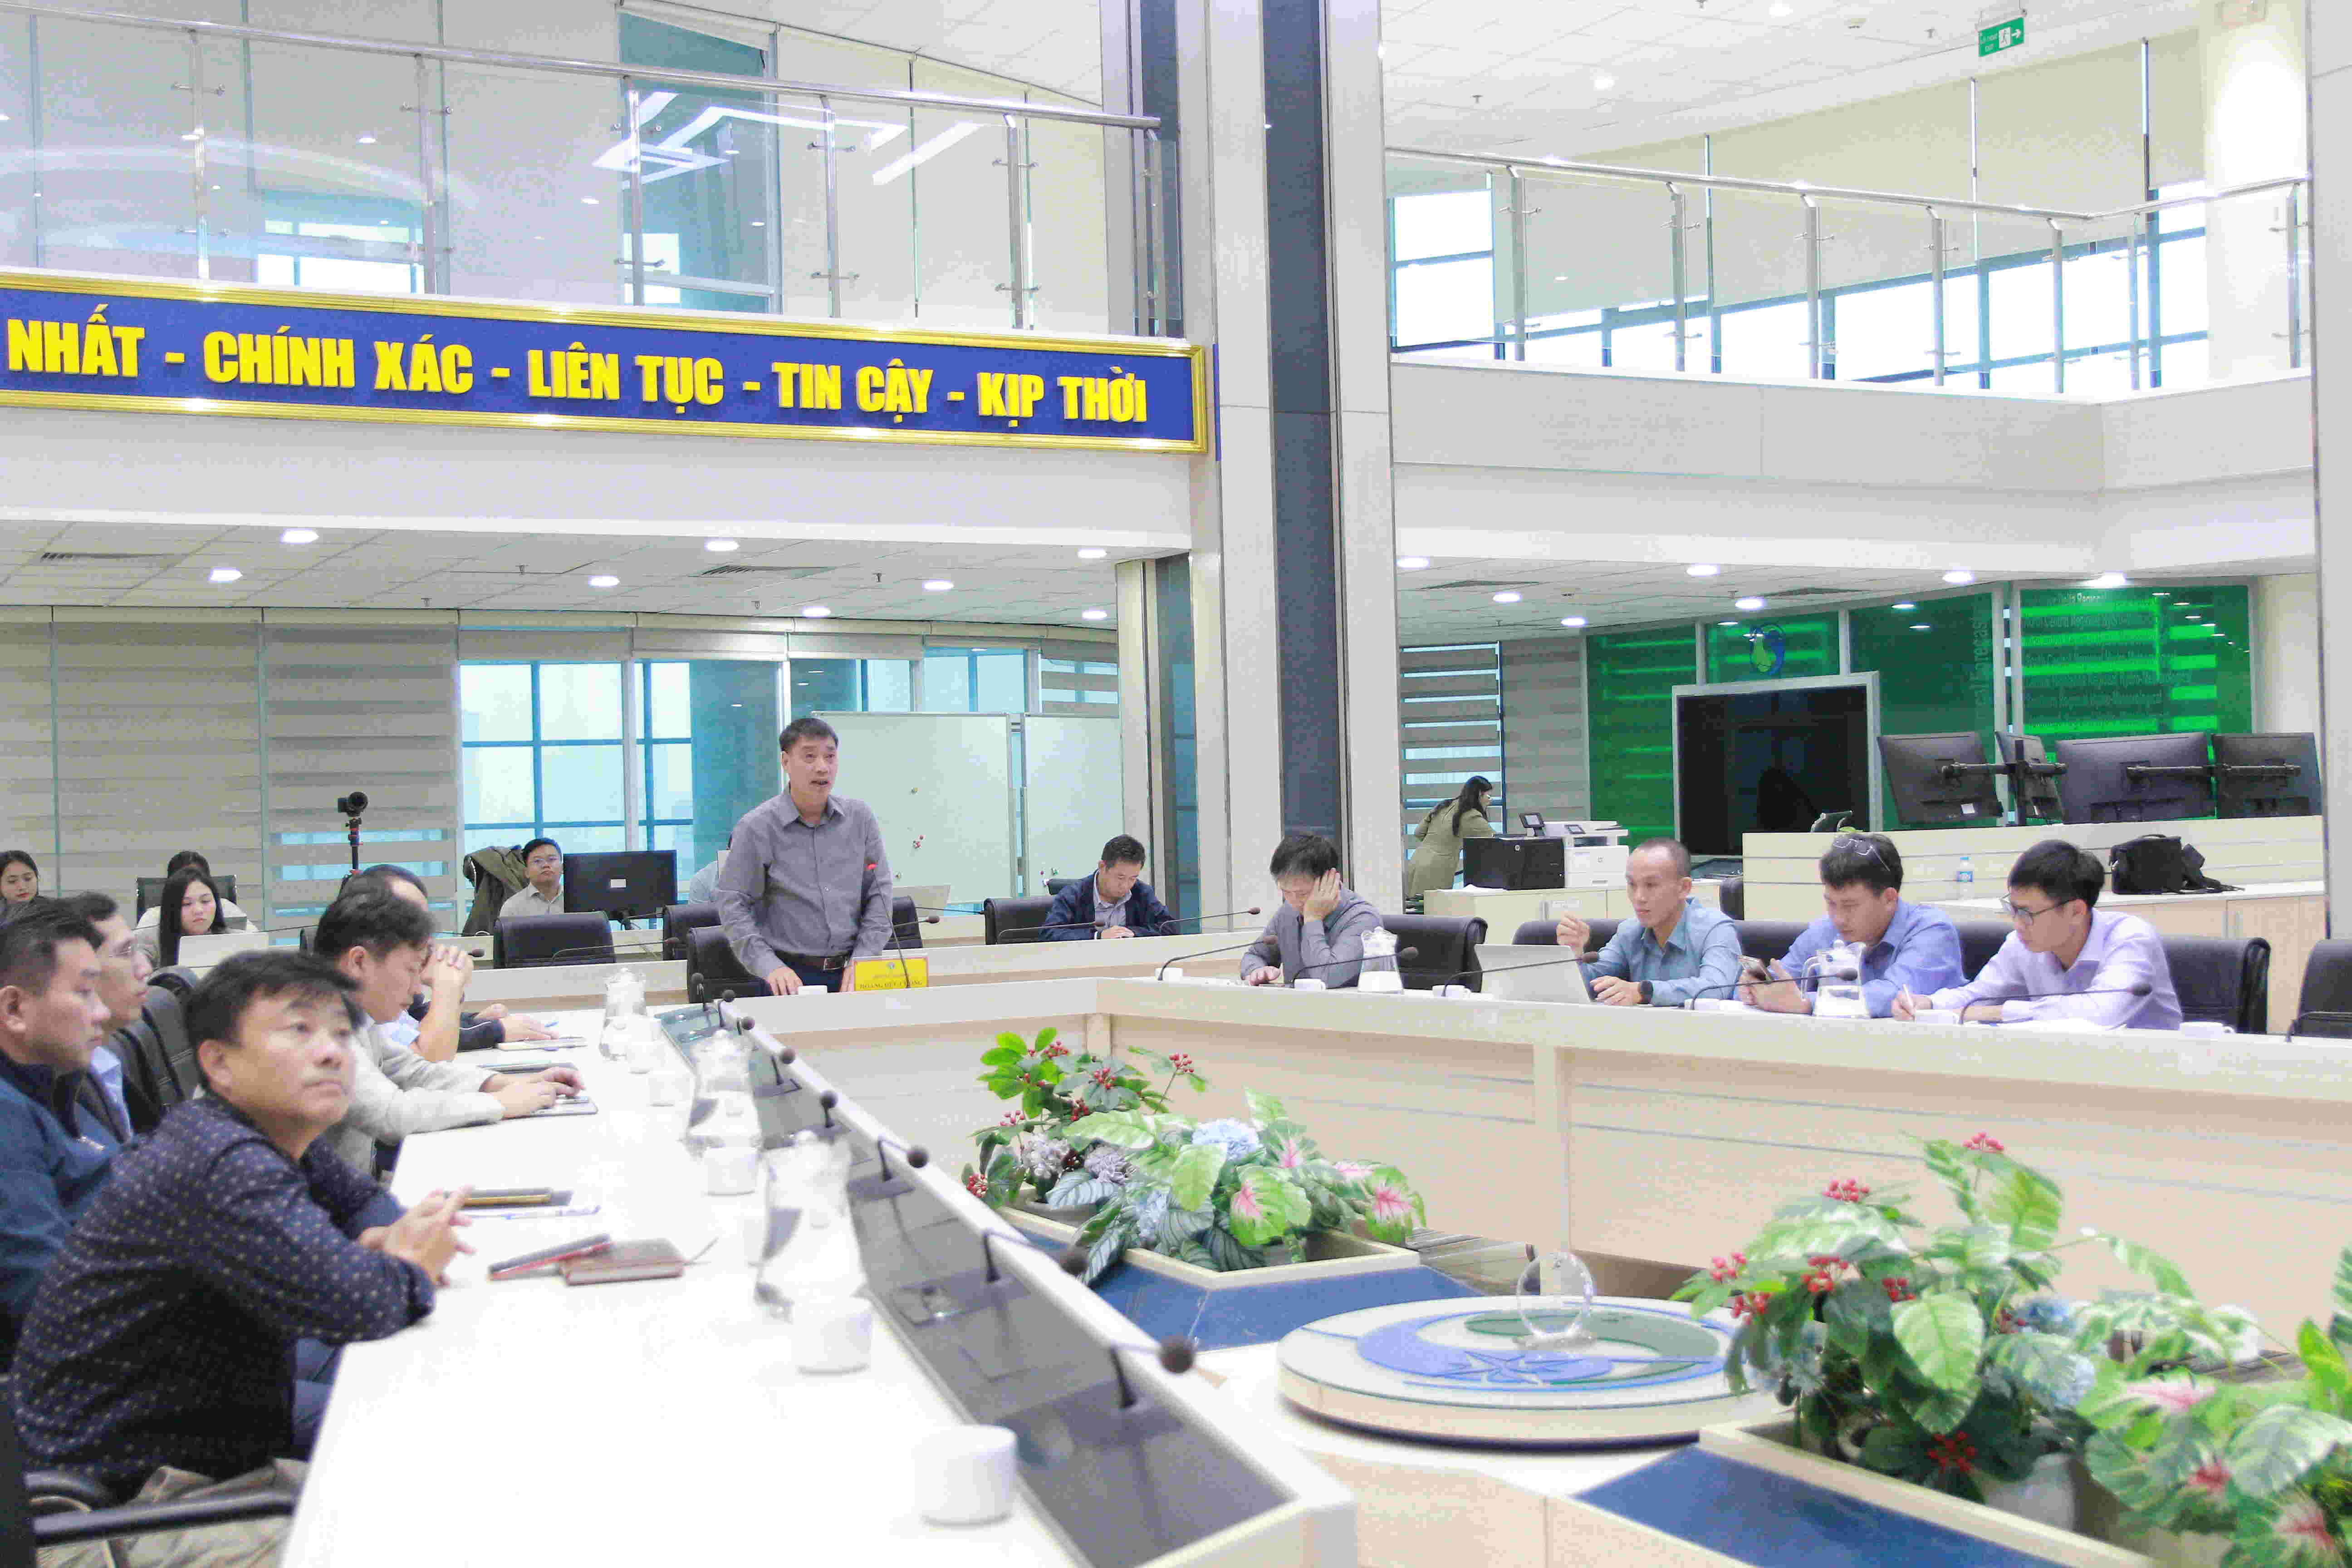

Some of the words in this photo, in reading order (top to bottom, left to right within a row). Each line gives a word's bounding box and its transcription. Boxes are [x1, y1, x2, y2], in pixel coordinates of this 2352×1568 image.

[7, 304, 145, 377] NHẤT
[204, 325, 356, 388] CHÍNH
[375, 333, 474, 394] XÁC
[529, 341, 621, 400] LIÊN
[636, 355, 725, 414] TỤC
[772, 362, 842, 410] TIN
[856, 358, 933, 422] CẬY
[978, 372, 1045, 427] KỊP
[1059, 366, 1148, 422] THỜI
